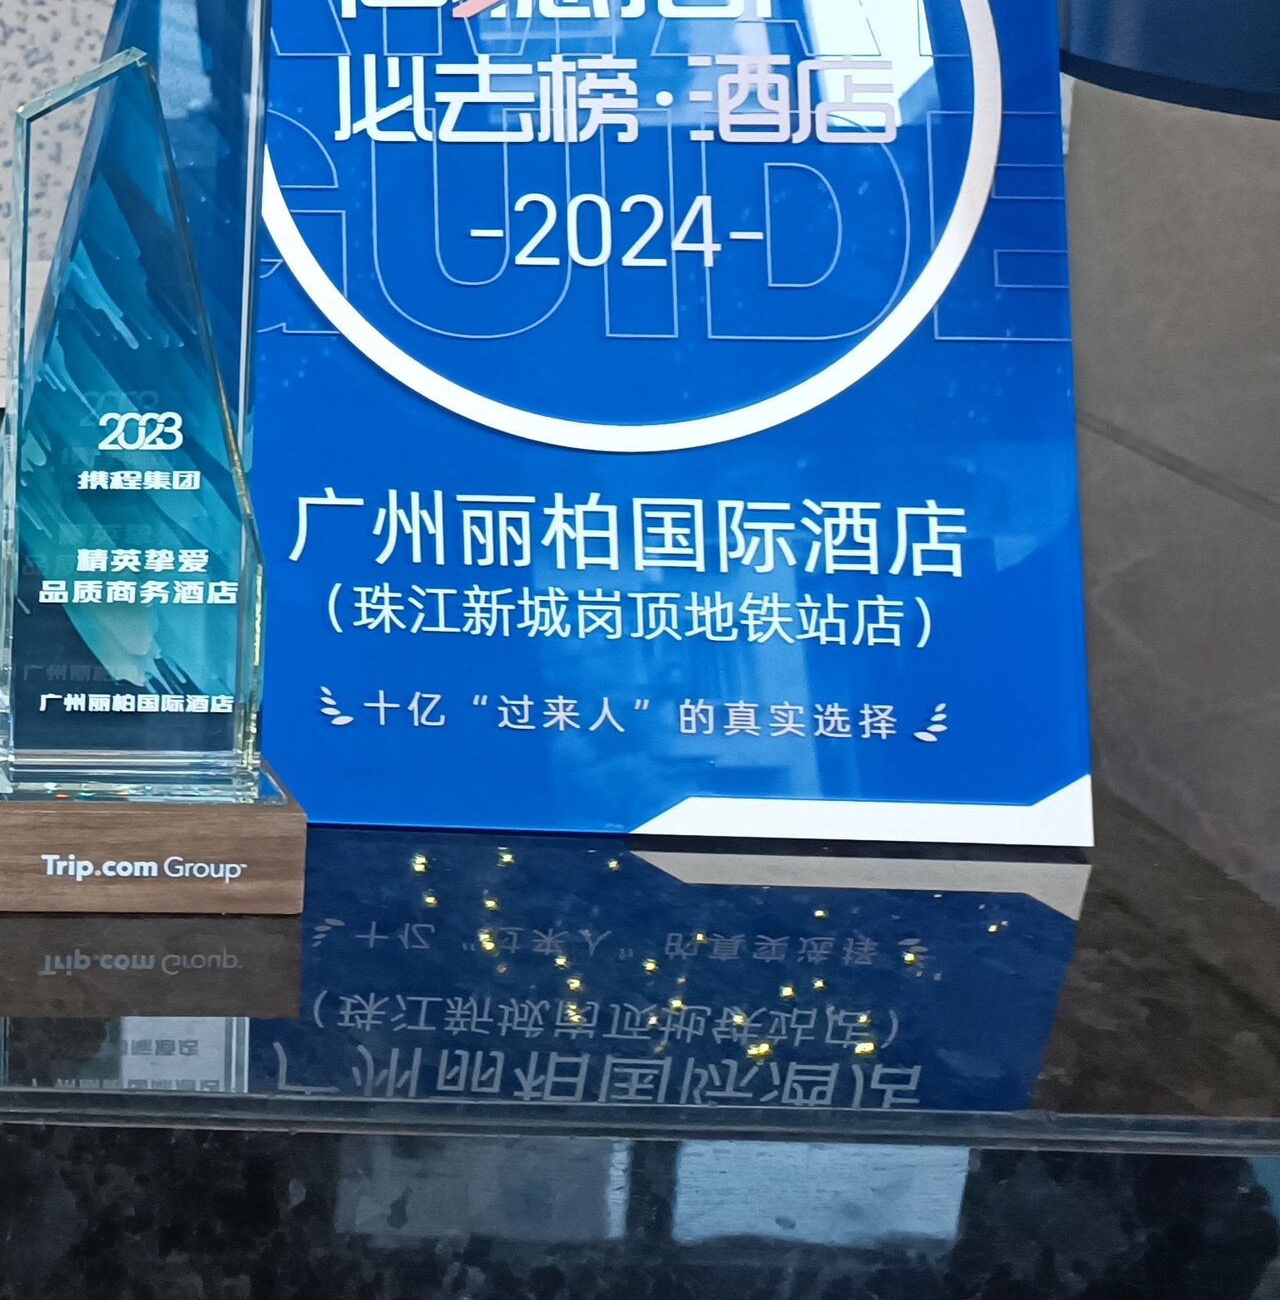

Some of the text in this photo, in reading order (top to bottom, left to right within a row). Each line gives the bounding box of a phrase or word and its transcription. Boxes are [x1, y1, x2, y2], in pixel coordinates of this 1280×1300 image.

[334, 53, 898, 144] 必去榜·酒店
[98, 411, 184, 451] 2023
[76, 469, 201, 491] 携程集团
[287, 487, 967, 579] 广州丽柏国际酒店
[75, 547, 209, 573] 精英挚爱
[38, 580, 239, 605] 品质商务酒店
[325, 583, 935, 651] （珠江新城岗顶地铁站店）
[38, 693, 235, 713] 广州丽柏国际酒店
[40, 853, 158, 881] Trip.com
